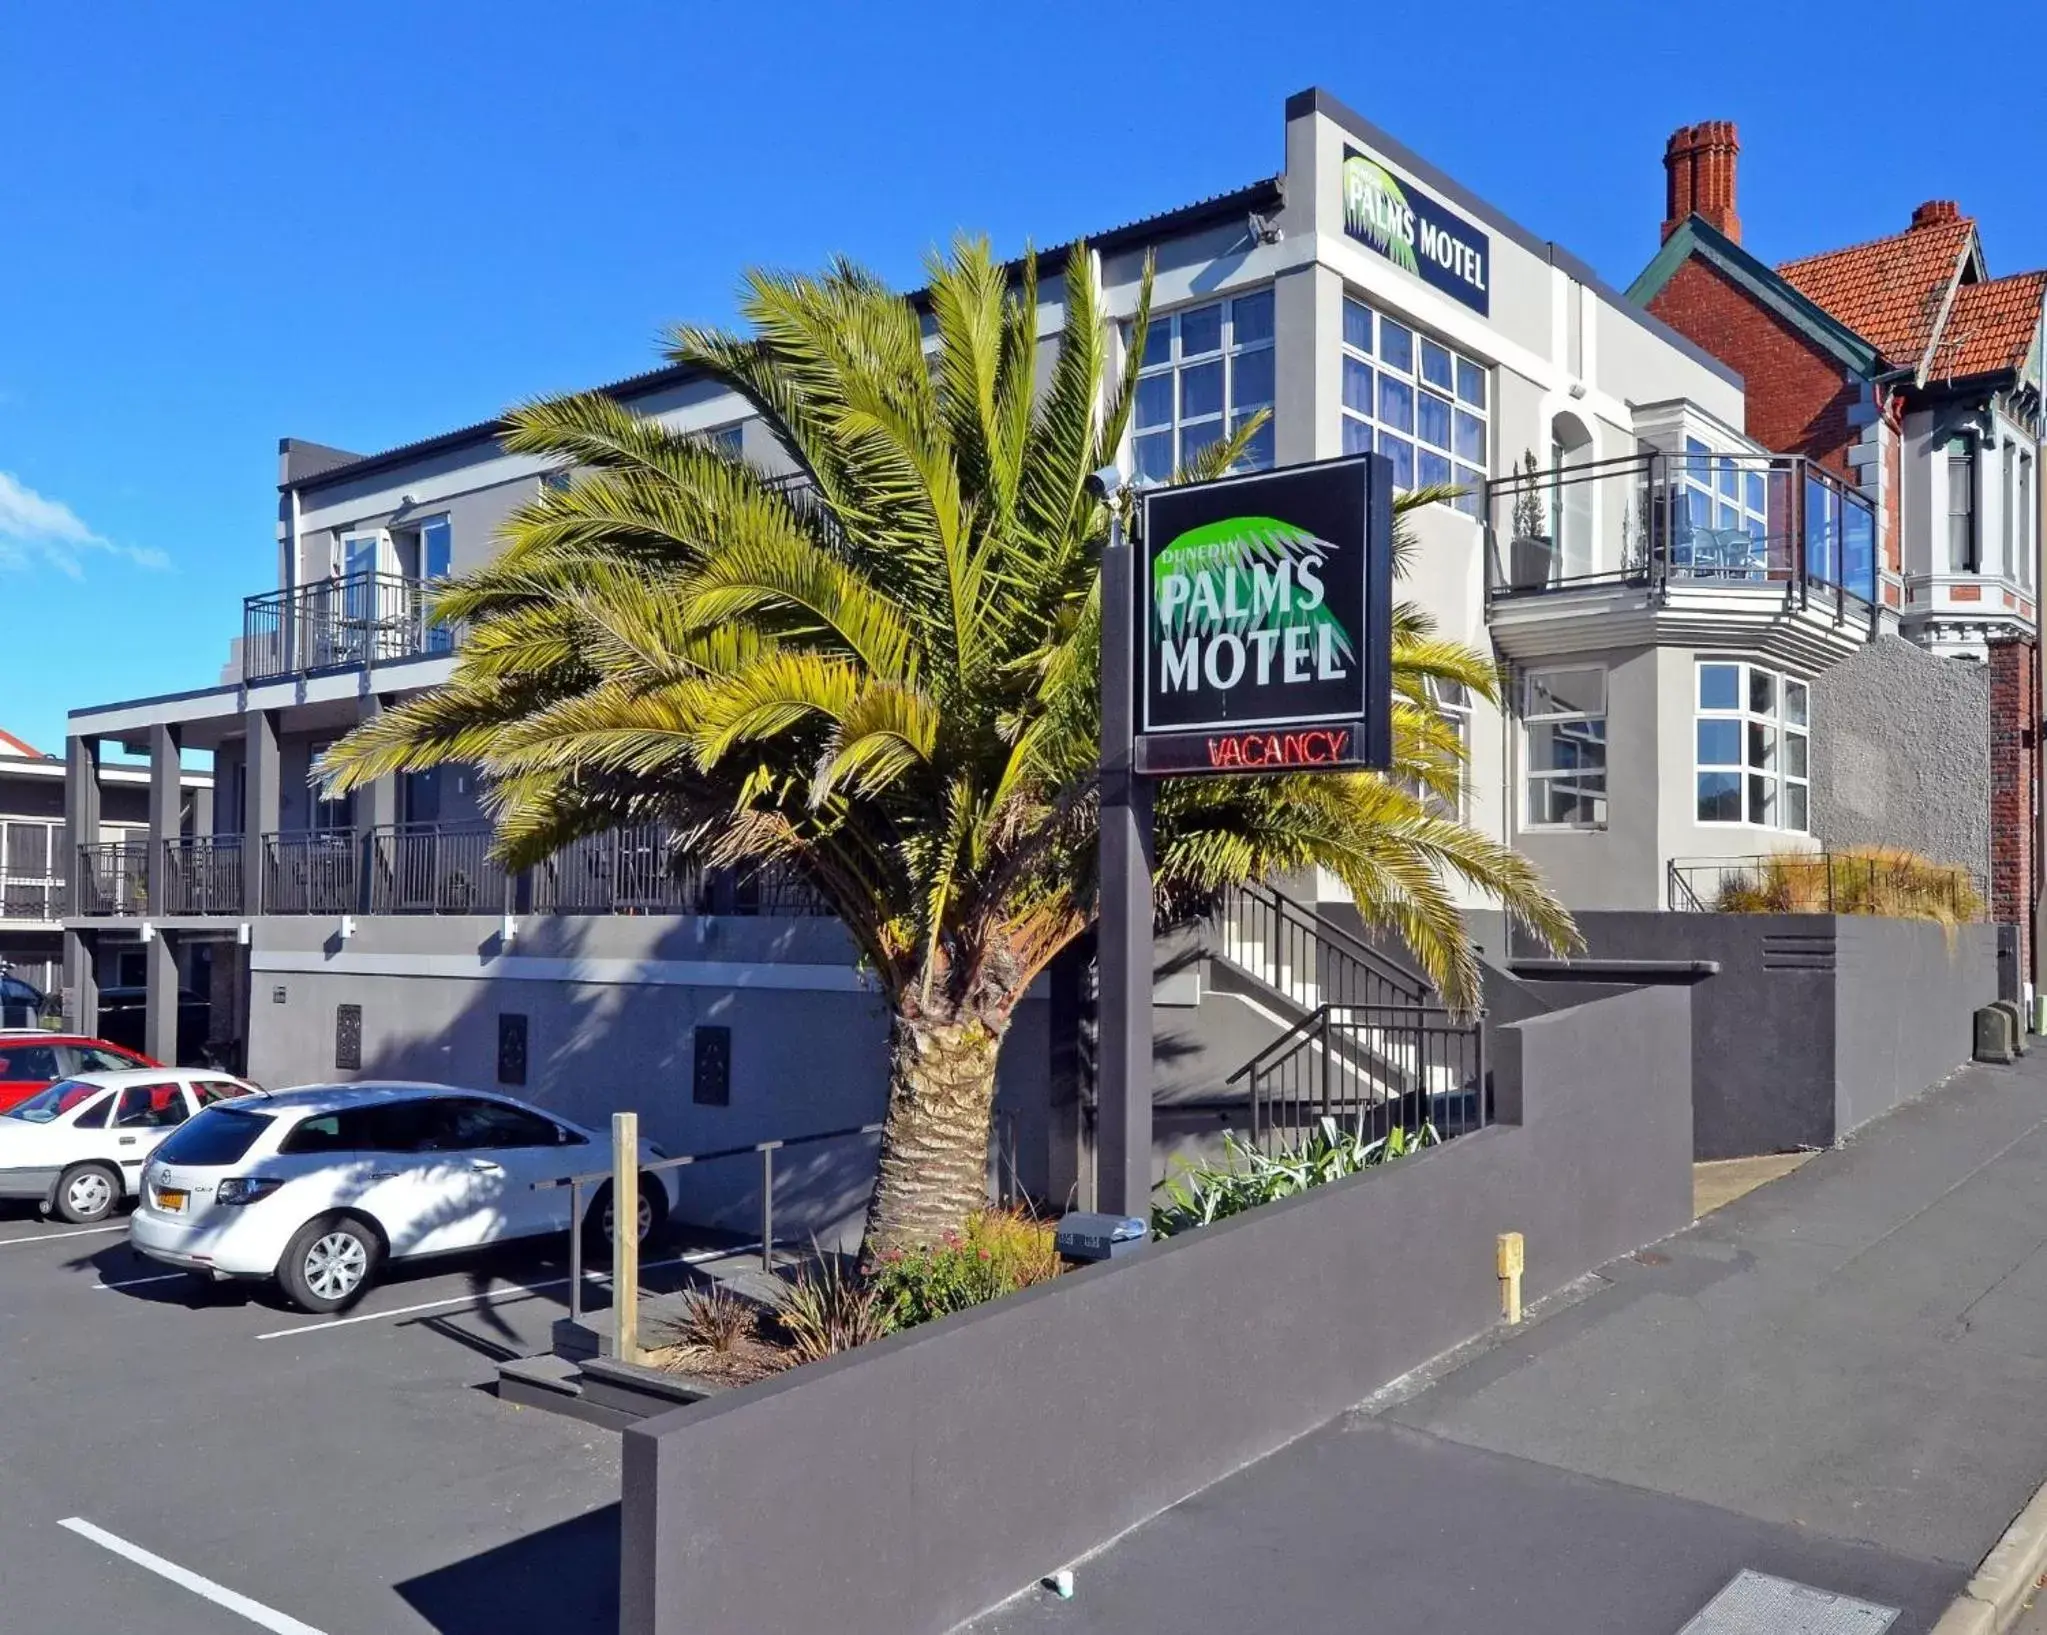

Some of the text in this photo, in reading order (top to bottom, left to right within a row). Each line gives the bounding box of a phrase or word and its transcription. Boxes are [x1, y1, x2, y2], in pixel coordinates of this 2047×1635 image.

[1349, 173, 1415, 246] PALMS
[1420, 218, 1486, 291] MOTEL
[1160, 540, 1241, 563] DUNEDIN
[1160, 554, 1325, 627] PALMS
[1160, 622, 1347, 694] MOTEL
[1207, 730, 1349, 767] VACANCY
